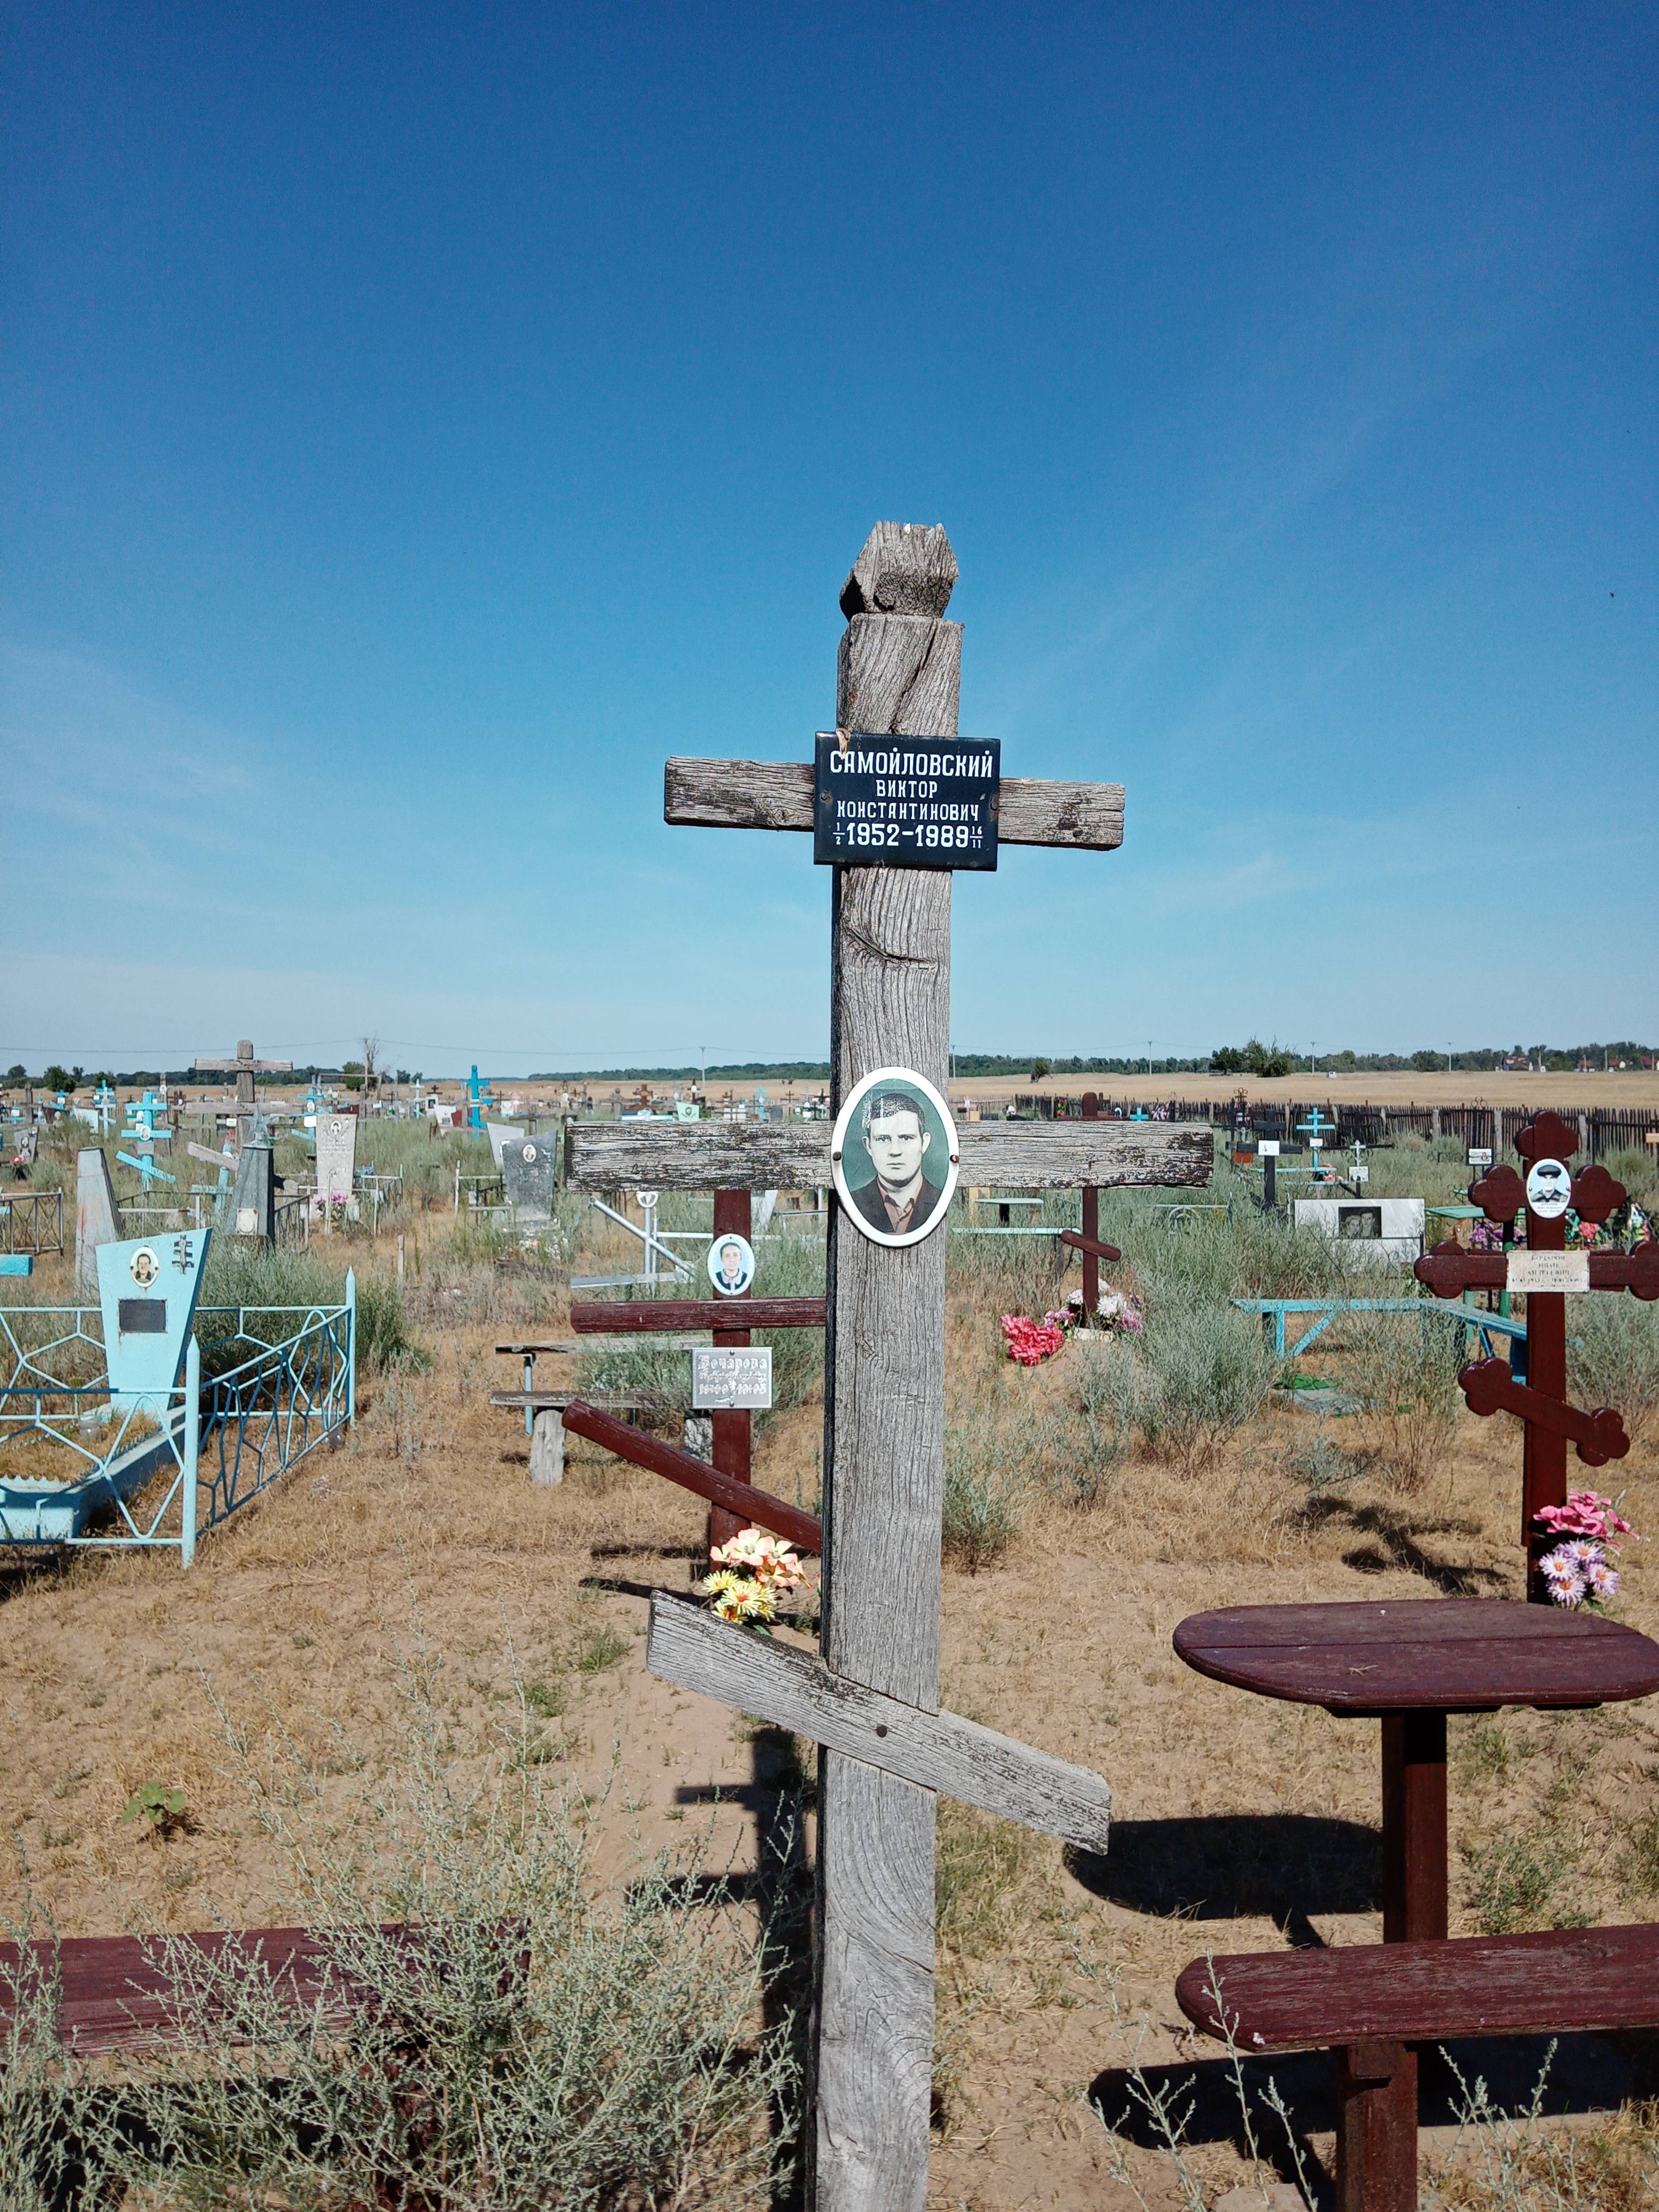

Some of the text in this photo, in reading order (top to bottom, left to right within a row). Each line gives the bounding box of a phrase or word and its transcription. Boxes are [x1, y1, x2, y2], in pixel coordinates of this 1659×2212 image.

[830, 747, 993, 777] САМОЙЛОВСКИЙ
[876, 780, 937, 798] ВИКТОР
[837, 801, 979, 821] КОНСТАНТИНОВИЧ
[847, 823, 969, 848] 1952-1989
